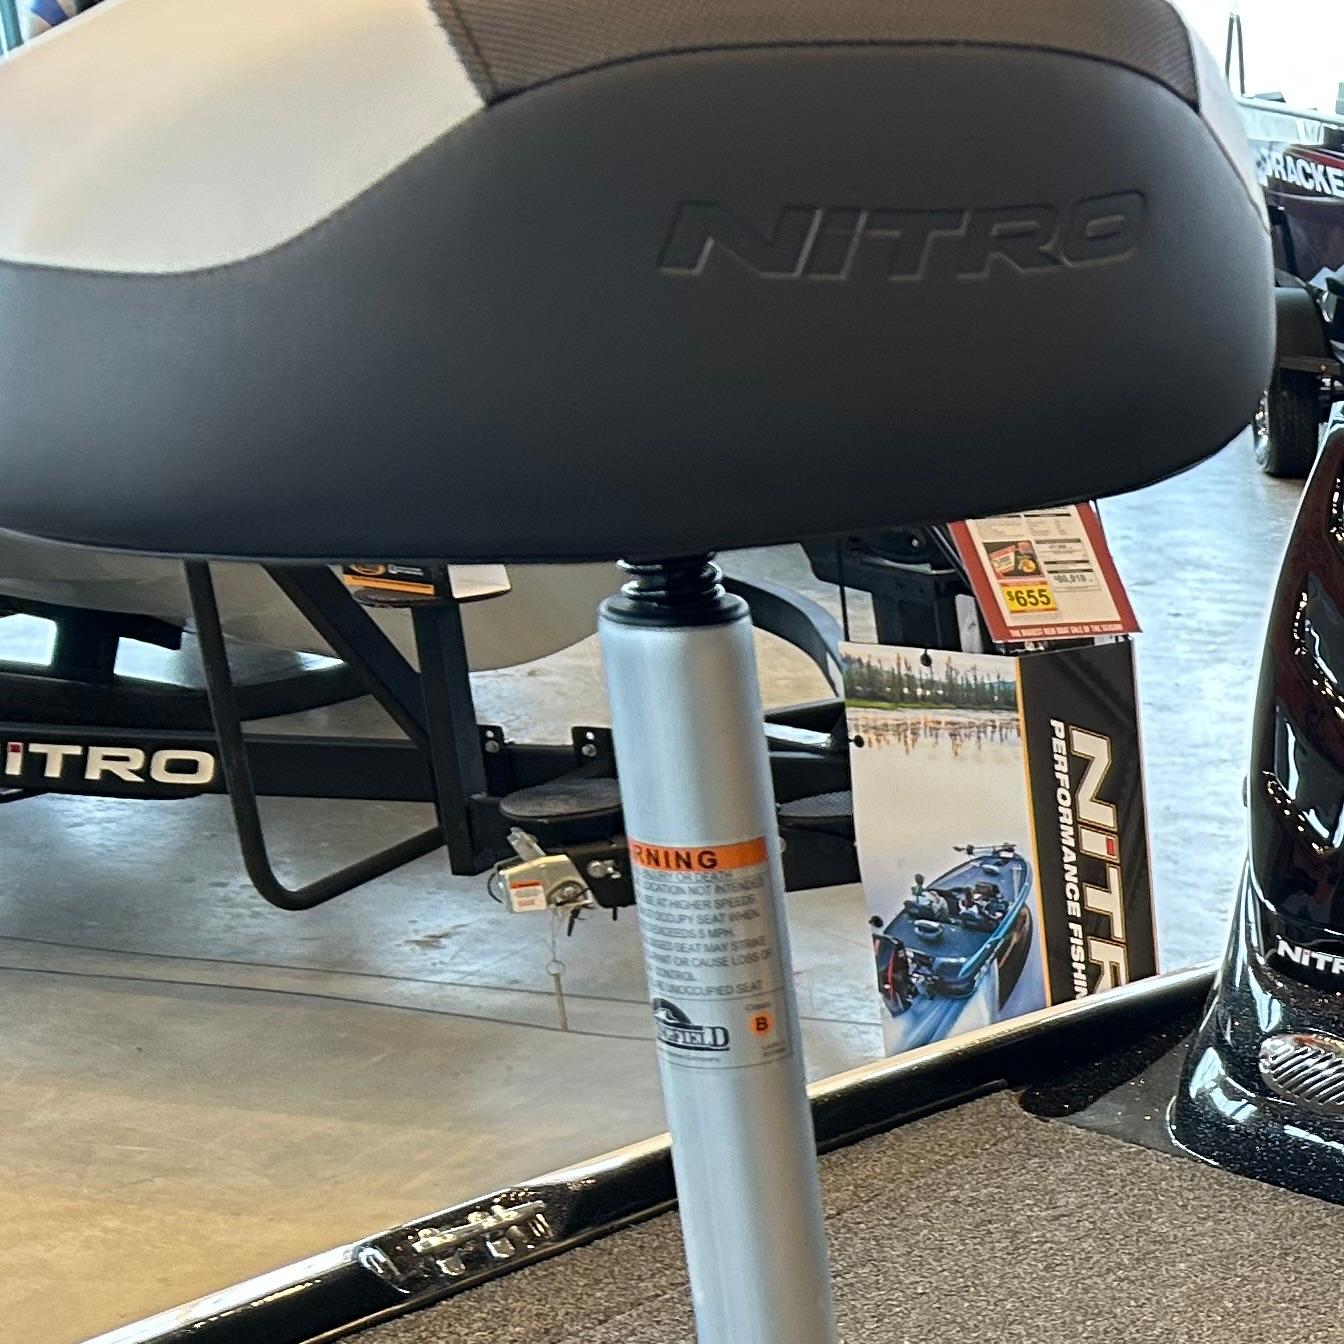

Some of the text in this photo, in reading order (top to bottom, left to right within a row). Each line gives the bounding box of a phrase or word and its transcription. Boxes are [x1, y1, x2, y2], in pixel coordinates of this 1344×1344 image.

[1006, 588, 1051, 608] $655
[630, 845, 718, 869] RNING
[1050, 719, 1090, 1001] PERFORMANCE FISHIN
[755, 1016, 769, 1032] B
